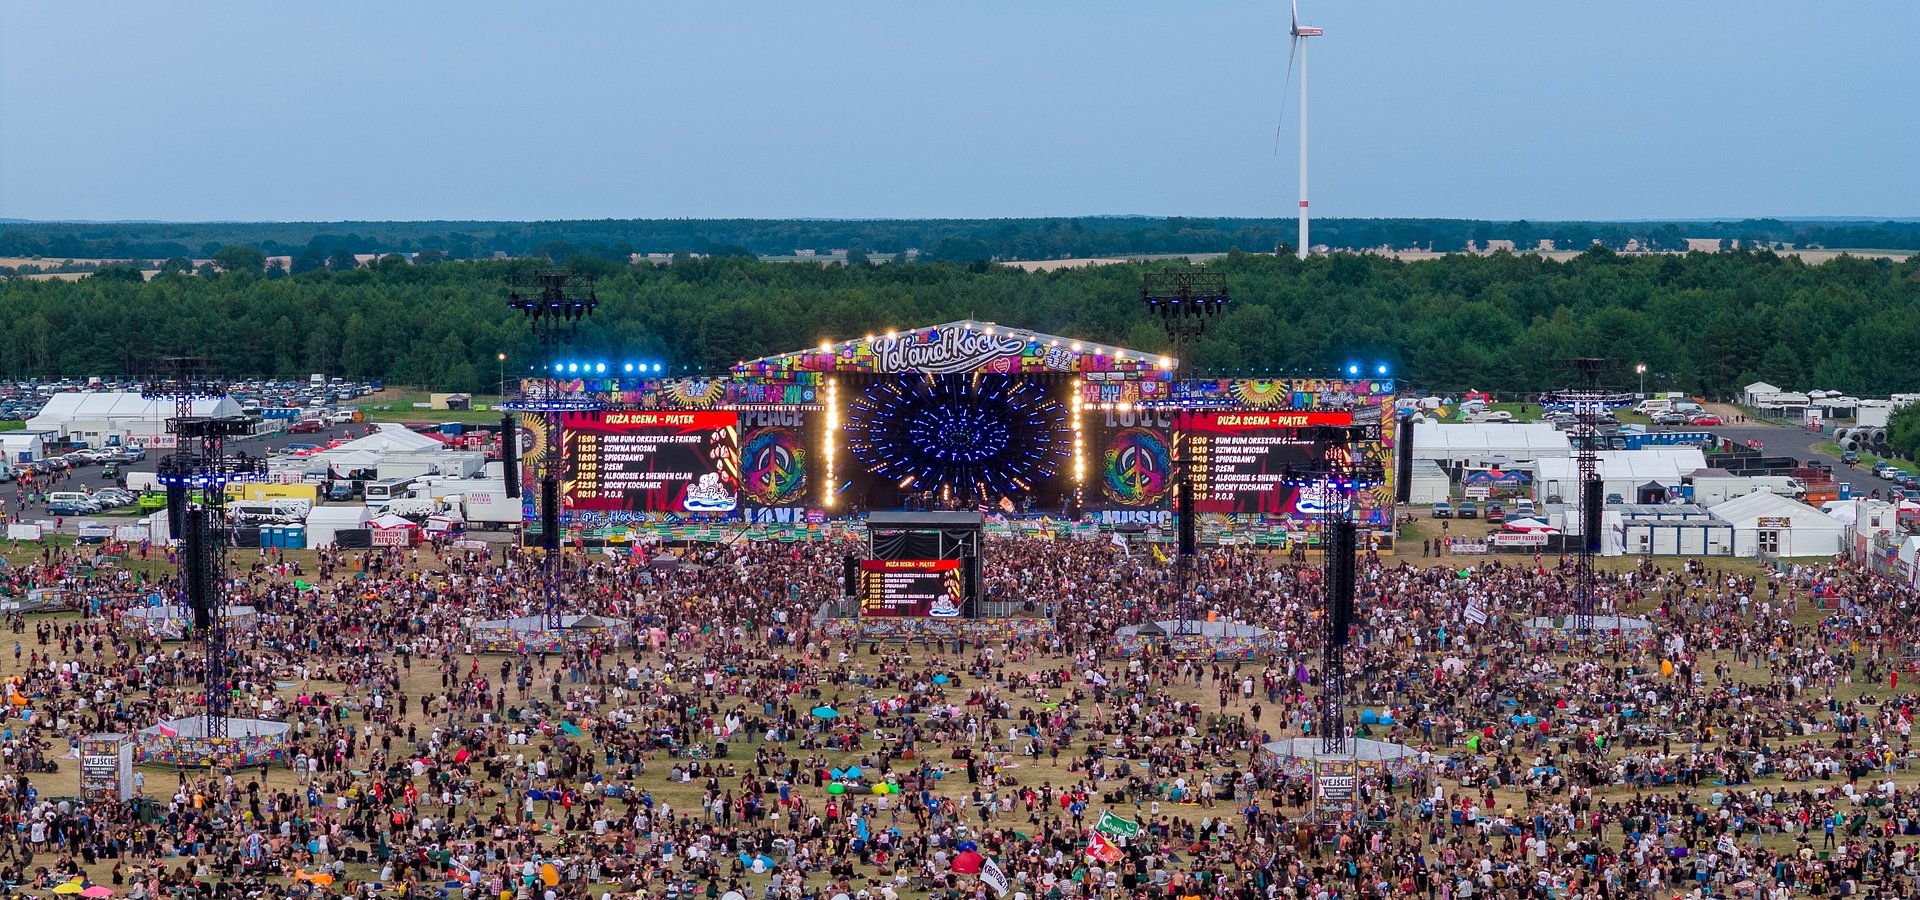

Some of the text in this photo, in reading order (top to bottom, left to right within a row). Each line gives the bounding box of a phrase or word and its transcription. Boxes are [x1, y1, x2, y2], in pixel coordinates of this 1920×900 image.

[784, 354, 836, 371] PEACE
[1046, 346, 1074, 372] 32
[686, 381, 707, 397] 32
[606, 414, 628, 424] DUŻA
[631, 415, 658, 424] SCENA
[665, 415, 694, 425] PIĄTEK
[745, 410, 803, 426] PEACE
[1217, 415, 1240, 425] DUŻA
[1243, 416, 1270, 425] SCENA
[1278, 416, 1308, 426] PIĄTEK
[604, 435, 619, 443] BUM
[620, 435, 635, 443] BUM
[636, 435, 668, 443] ORKESTAR
[1215, 446, 1242, 454] DZIWNA
[675, 472, 692, 480] CLAN
[1257, 474, 1283, 482] SHENGE
[604, 481, 627, 489] NOCNY
[627, 481, 662, 489] KOCHANEK
[1215, 483, 1238, 491] NOCNY
[1239, 483, 1273, 491] KOCHANEK
[1102, 510, 1172, 526] MUSIC
[84, 756, 114, 765] WEJŚCIE
[1321, 778, 1352, 786] WEJŚCIE
[1102, 815, 1133, 837] Chatham
